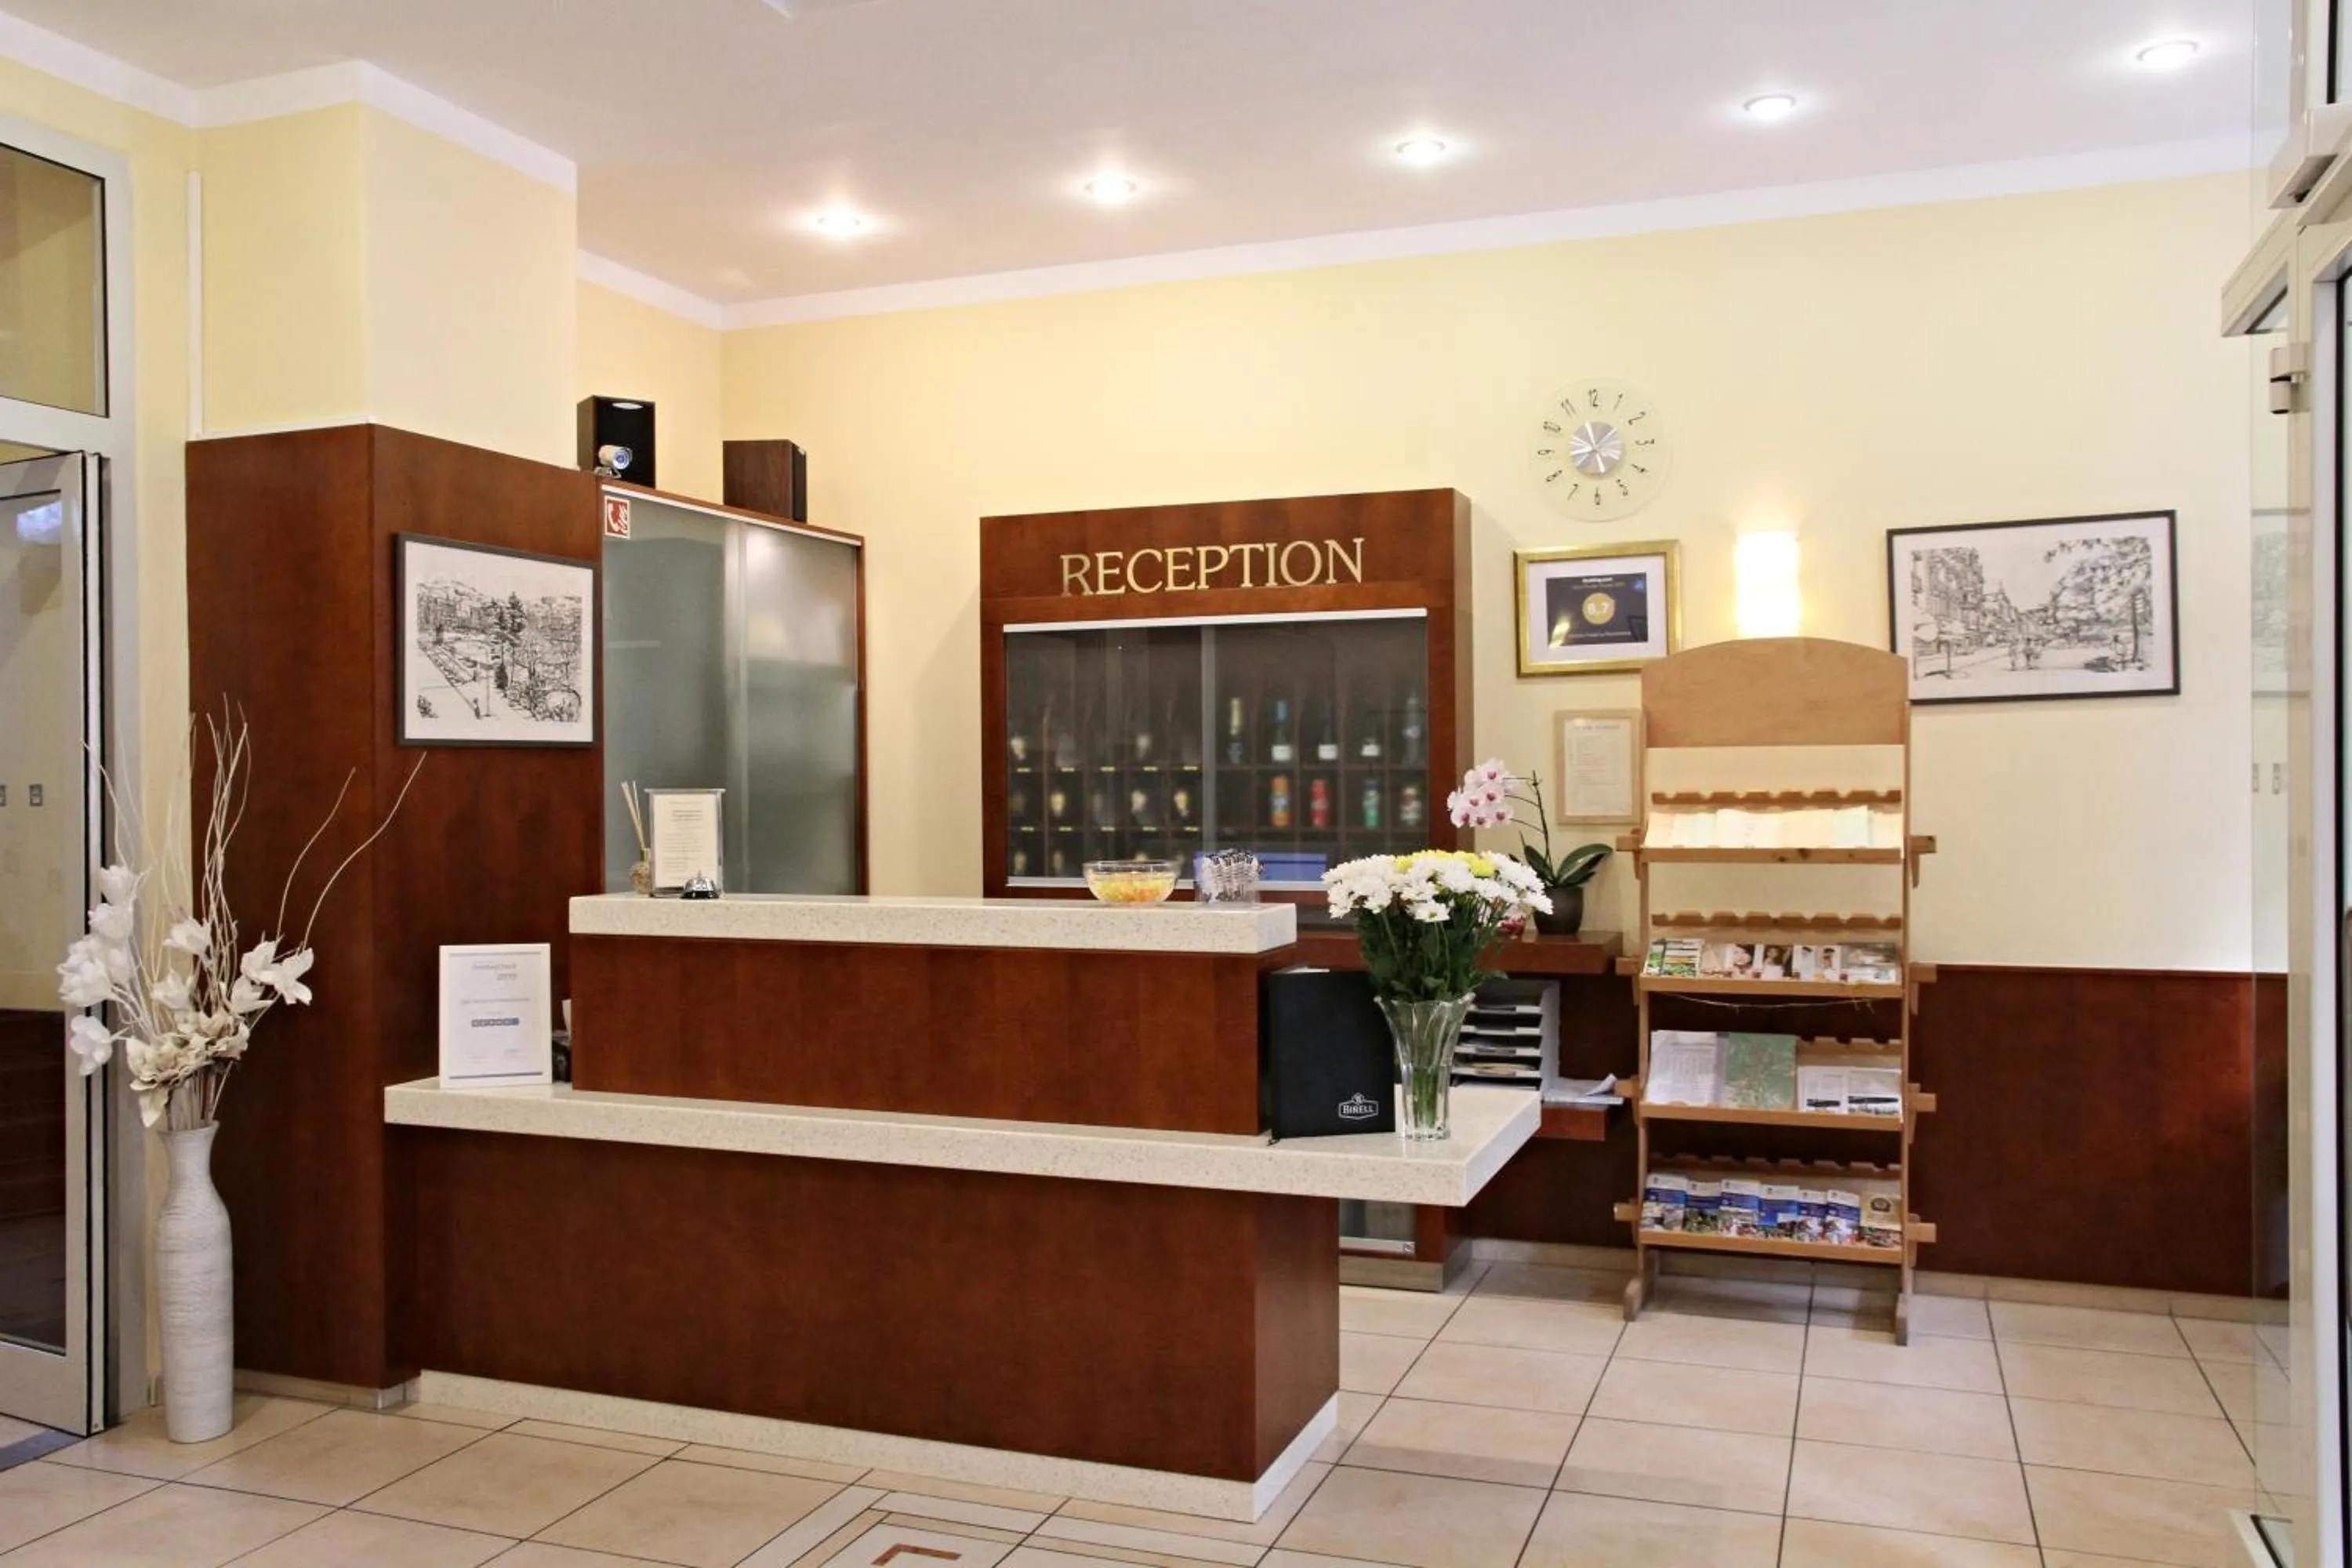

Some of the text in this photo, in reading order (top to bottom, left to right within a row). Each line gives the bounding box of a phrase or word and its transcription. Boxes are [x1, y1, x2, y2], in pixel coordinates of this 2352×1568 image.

[1560, 398, 1577, 416] 11
[1588, 388, 1599, 408] 12
[1613, 393, 1624, 411] 1
[1628, 410, 1646, 426] 2
[1545, 469, 1563, 483] 8
[1631, 463, 1649, 474] 4
[1566, 482, 1579, 501] 7
[1615, 478, 1628, 496] 5
[1593, 487, 1602, 506] 6
[1059, 538, 1365, 597] RECEPTION
[1343, 1105, 1374, 1114] BIRELL
